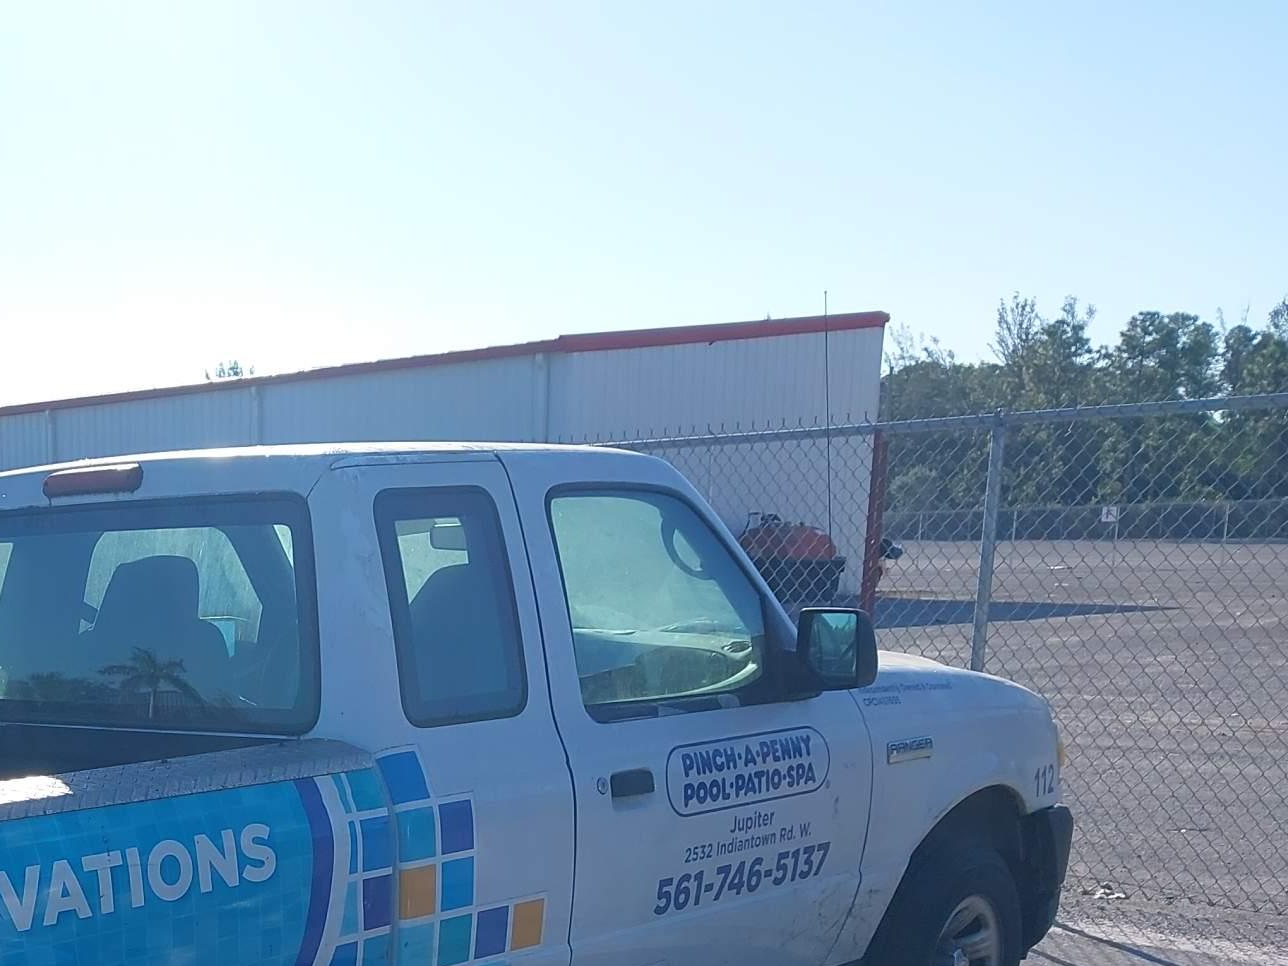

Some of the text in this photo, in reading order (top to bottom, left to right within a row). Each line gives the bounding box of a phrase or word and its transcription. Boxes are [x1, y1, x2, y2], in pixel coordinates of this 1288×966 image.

[1034, 763, 1055, 798] 112
[730, 811, 776, 835] Jupiter
[684, 822, 812, 864] 2532 Indiantown Rd. W.
[653, 841, 832, 916] 561-746-5137
